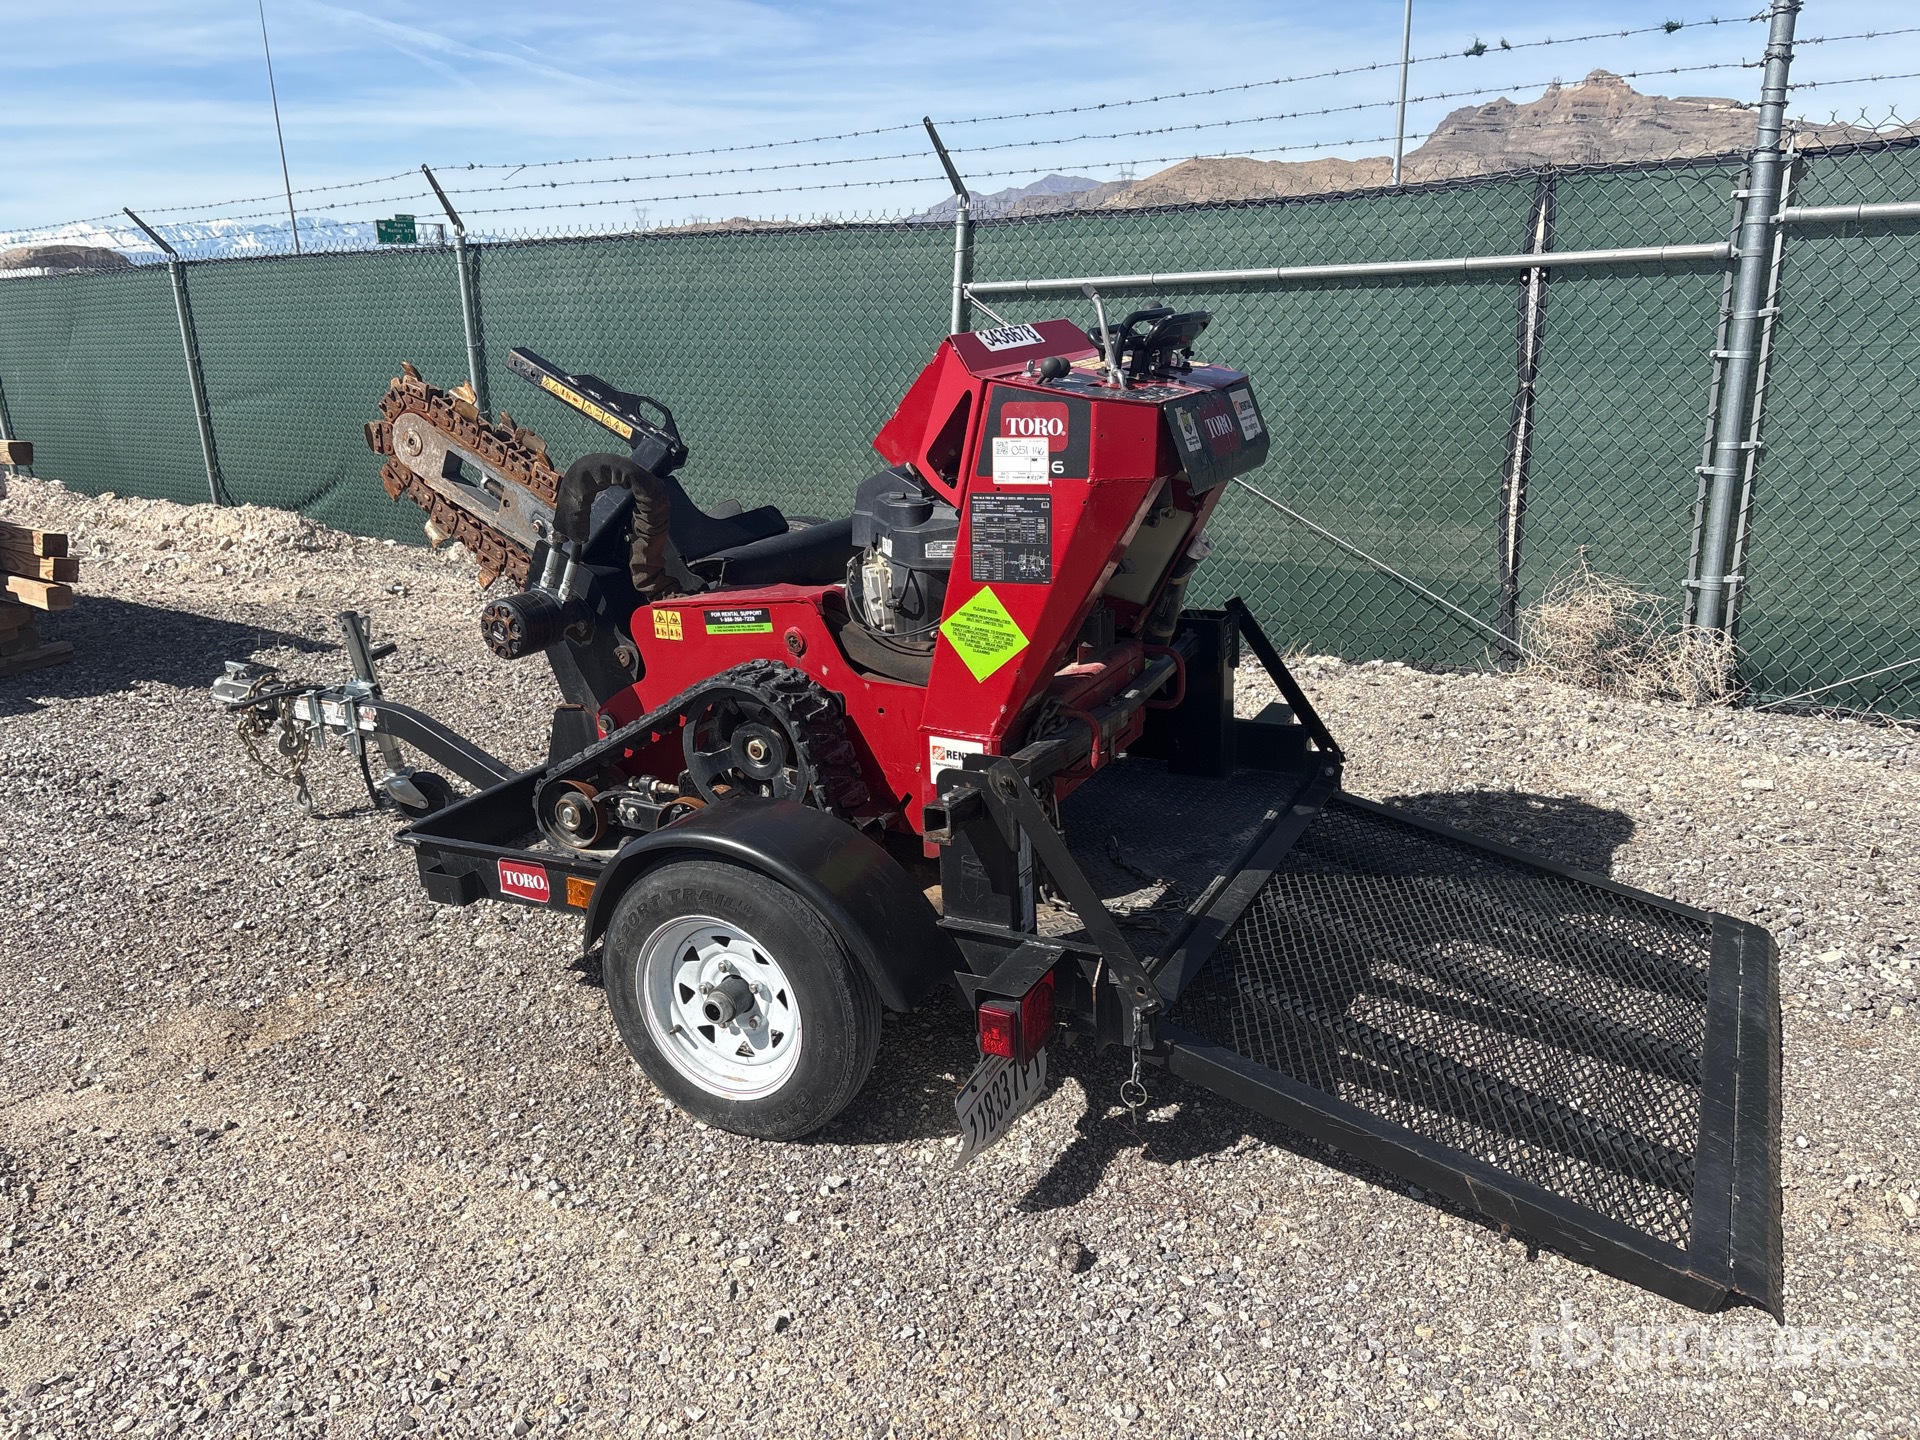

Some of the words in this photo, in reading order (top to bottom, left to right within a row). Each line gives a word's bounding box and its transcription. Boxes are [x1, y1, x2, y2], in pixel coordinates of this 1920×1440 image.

[979, 325, 1037, 346] 3436678
[1006, 418, 1064, 436] TORO
[1204, 413, 1232, 438] TORO
[946, 750, 967, 760] REN
[503, 870, 544, 890] TORO
